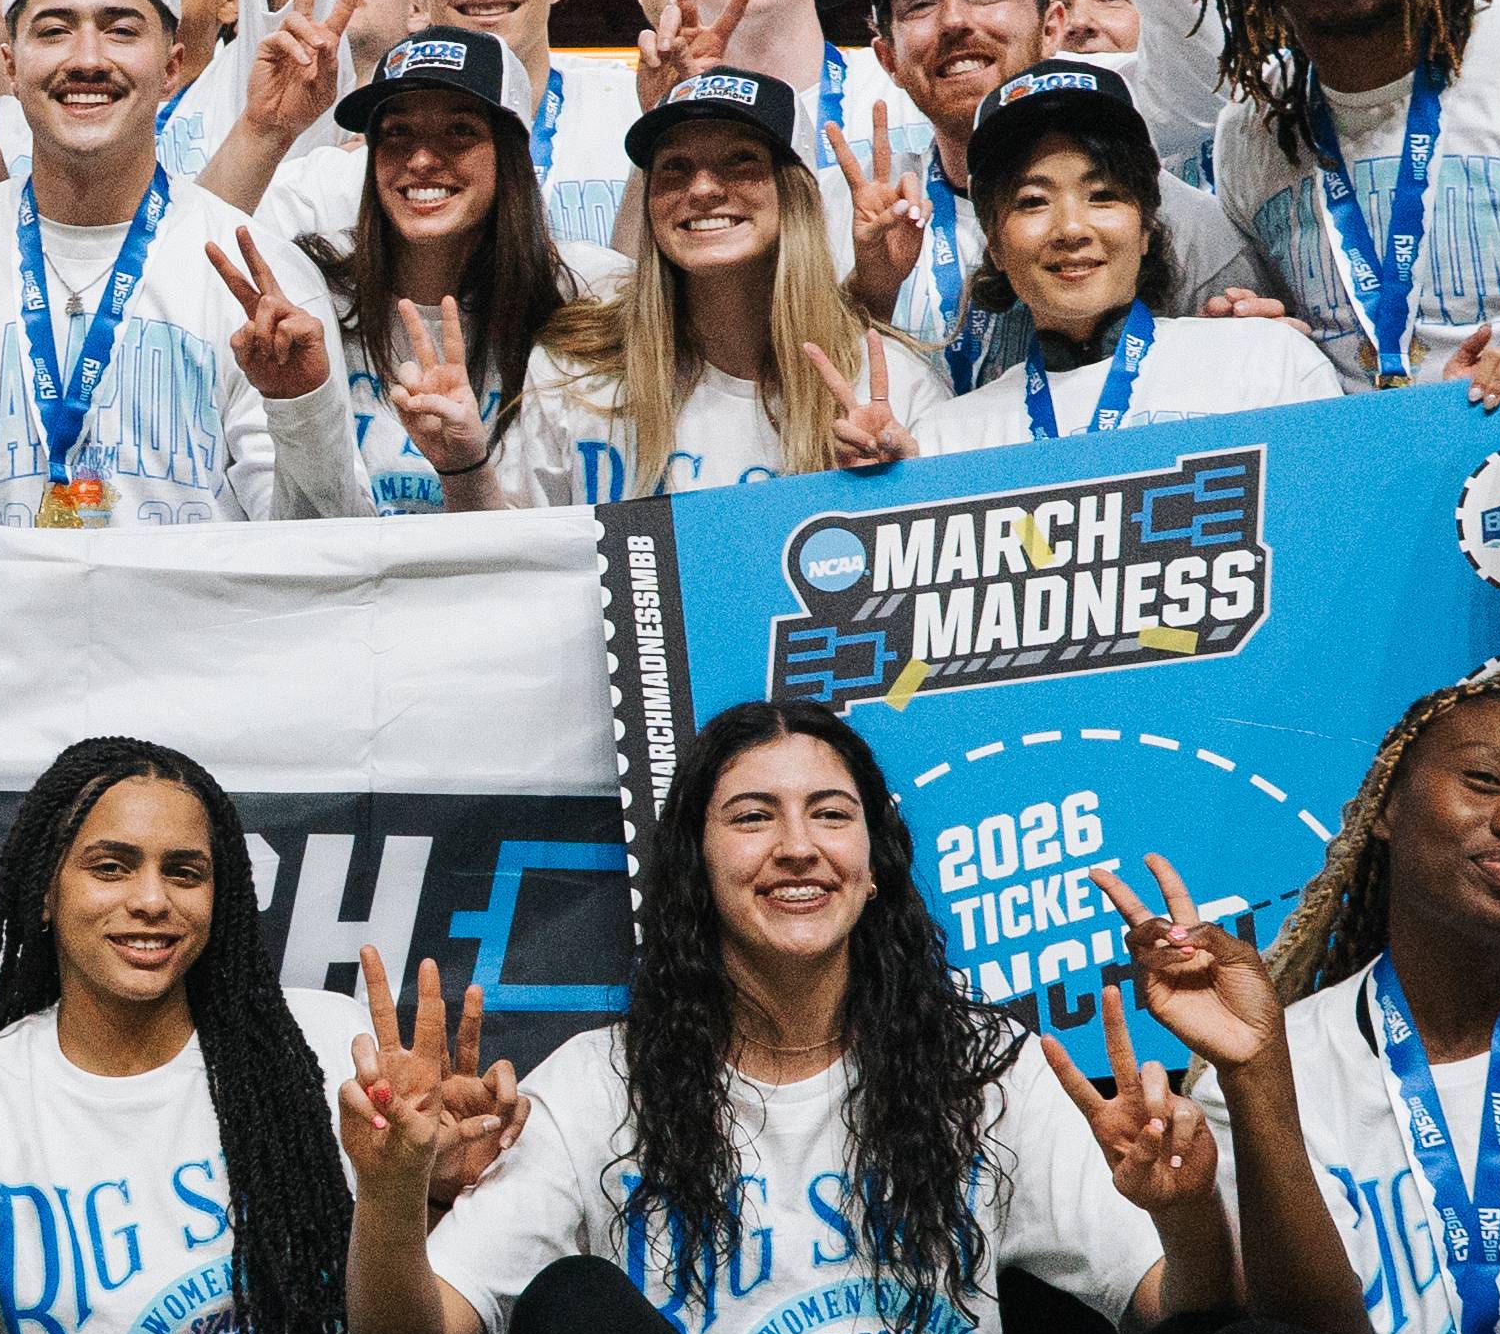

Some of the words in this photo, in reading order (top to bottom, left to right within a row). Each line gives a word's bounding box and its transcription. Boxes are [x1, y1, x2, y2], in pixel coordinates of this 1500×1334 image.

[407, 43, 465, 61] 2026
[694, 88, 753, 104] CHAMPIONS
[699, 77, 755, 96] 2026
[1031, 74, 1097, 95] 2026
[872, 491, 1123, 593] MARCH
[807, 553, 866, 579] NCAA
[912, 548, 1256, 661] MADNESS
[936, 789, 1104, 894] 2026
[950, 857, 1121, 952] TICKET
[1408, 1095, 1446, 1149] BIGSKY
